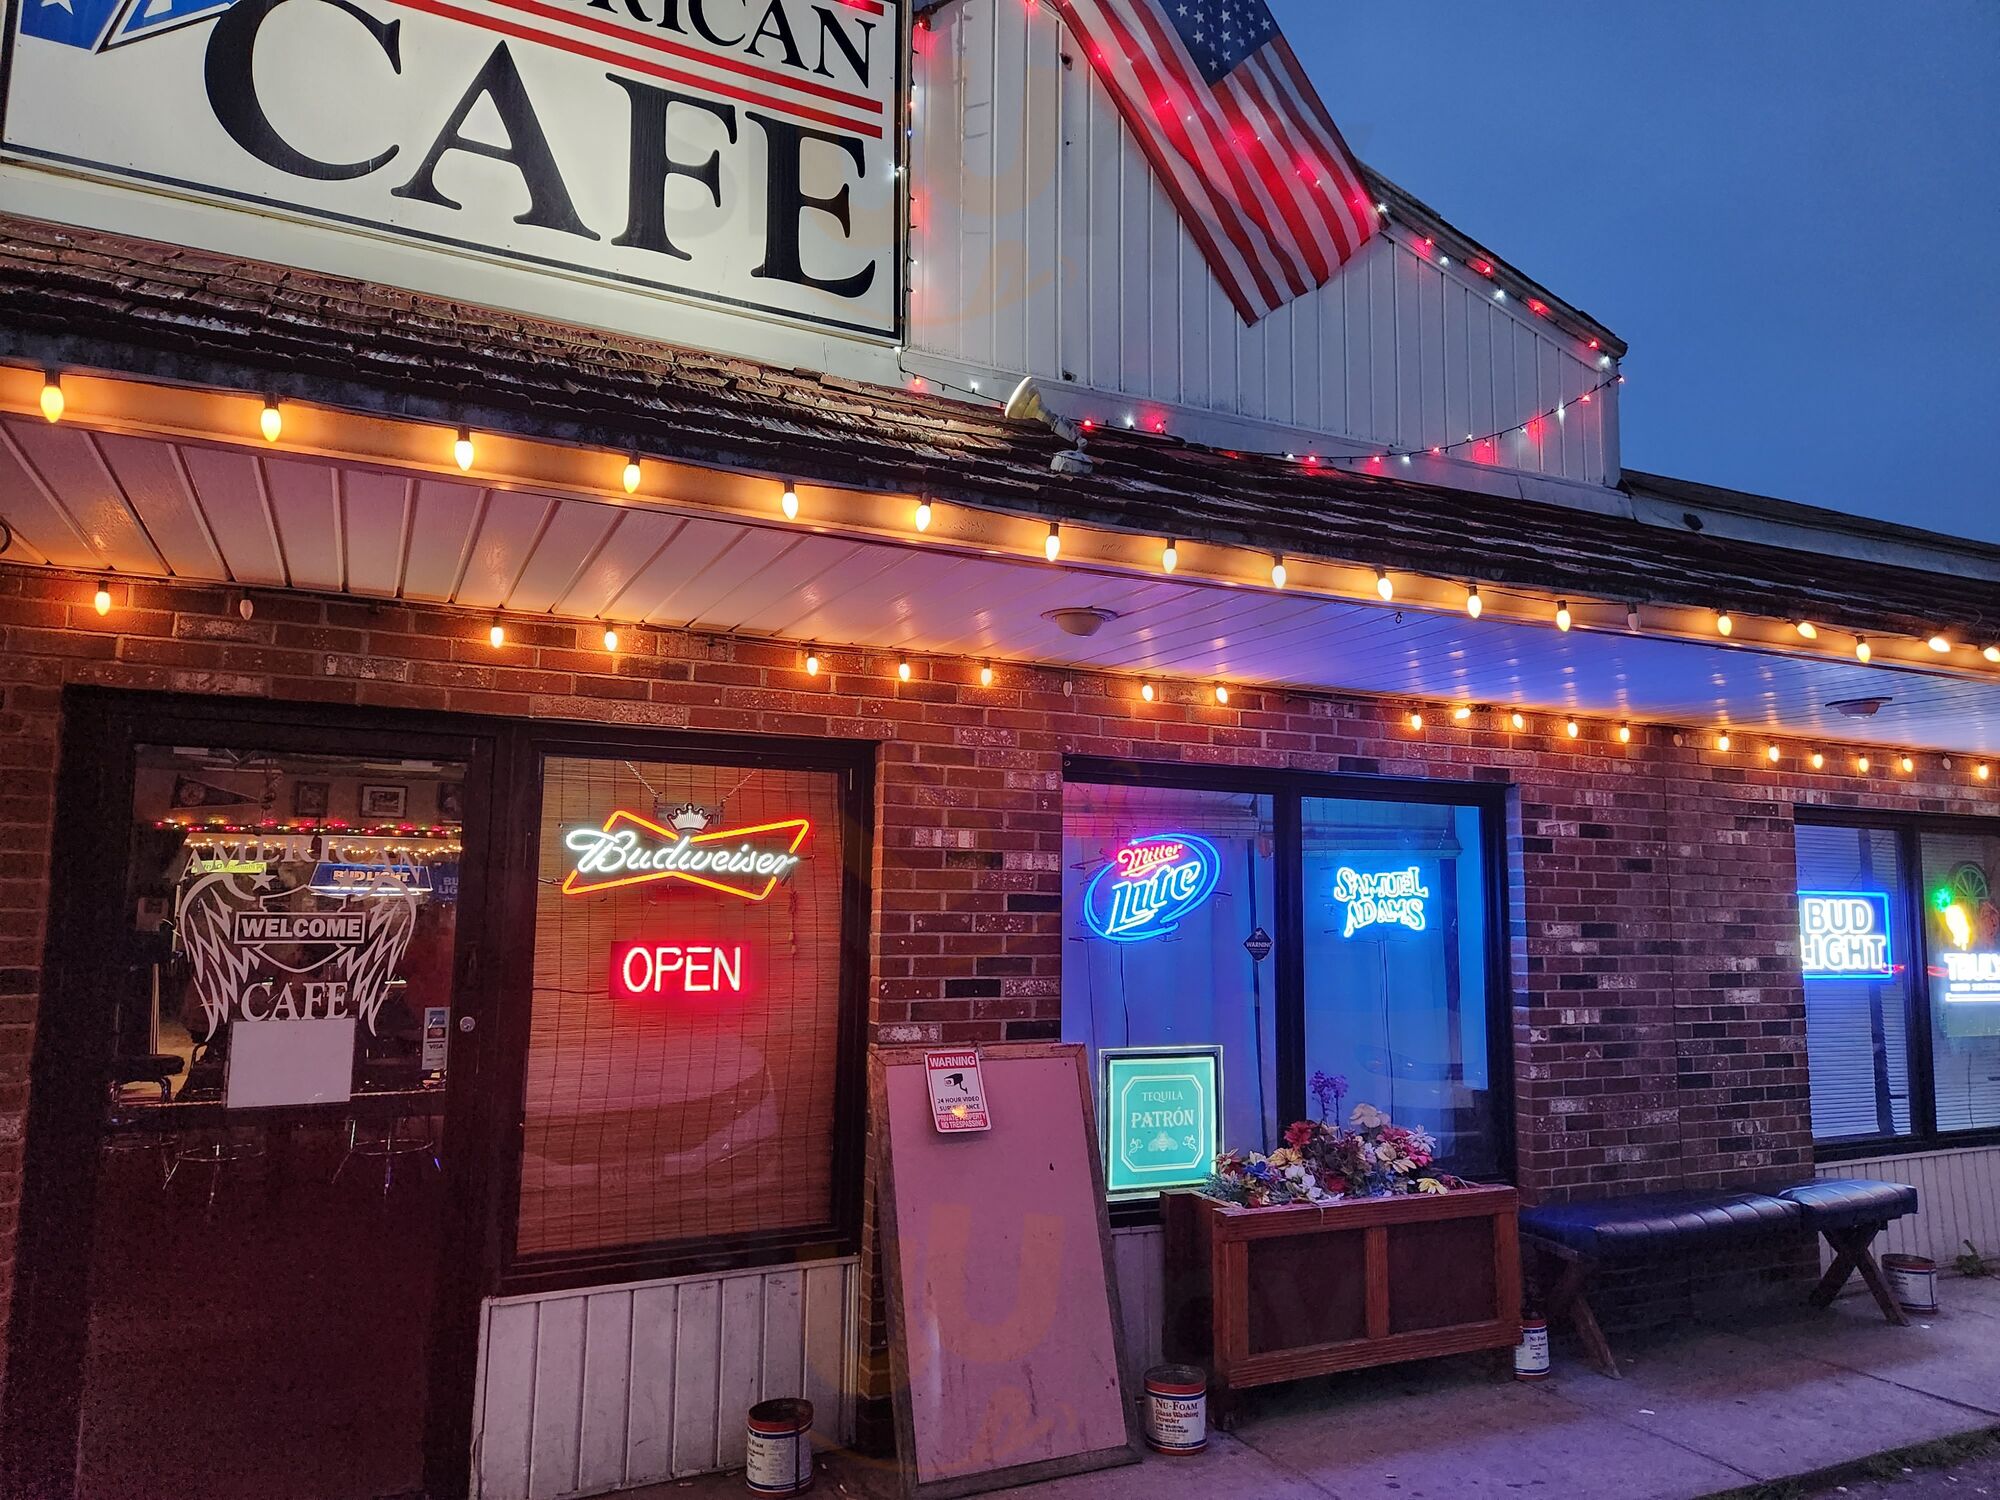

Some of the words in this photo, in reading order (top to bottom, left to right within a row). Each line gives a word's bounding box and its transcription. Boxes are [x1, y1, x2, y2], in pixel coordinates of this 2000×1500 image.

[204, 0, 876, 298] CAFE
[179, 834, 423, 884] AMERICAN
[565, 828, 798, 875] Budweiser
[1117, 843, 1183, 871] Miller
[1105, 861, 1201, 935] Lite
[1333, 866, 1429, 902] SAMUEL
[241, 918, 361, 938] WELCOME
[1343, 898, 1426, 938] ADAMS
[1803, 898, 1875, 935] BUD
[622, 947, 741, 992] OPEN
[241, 982, 348, 1021] CAFE
[929, 1055, 976, 1067] WARNING
[939, 1103, 980, 1112] SURANCE
[1142, 1090, 1184, 1103] TEQUILA
[1131, 1106, 1195, 1129] PATRÓN
[1155, 1399, 1198, 1411] NU-FOAM
